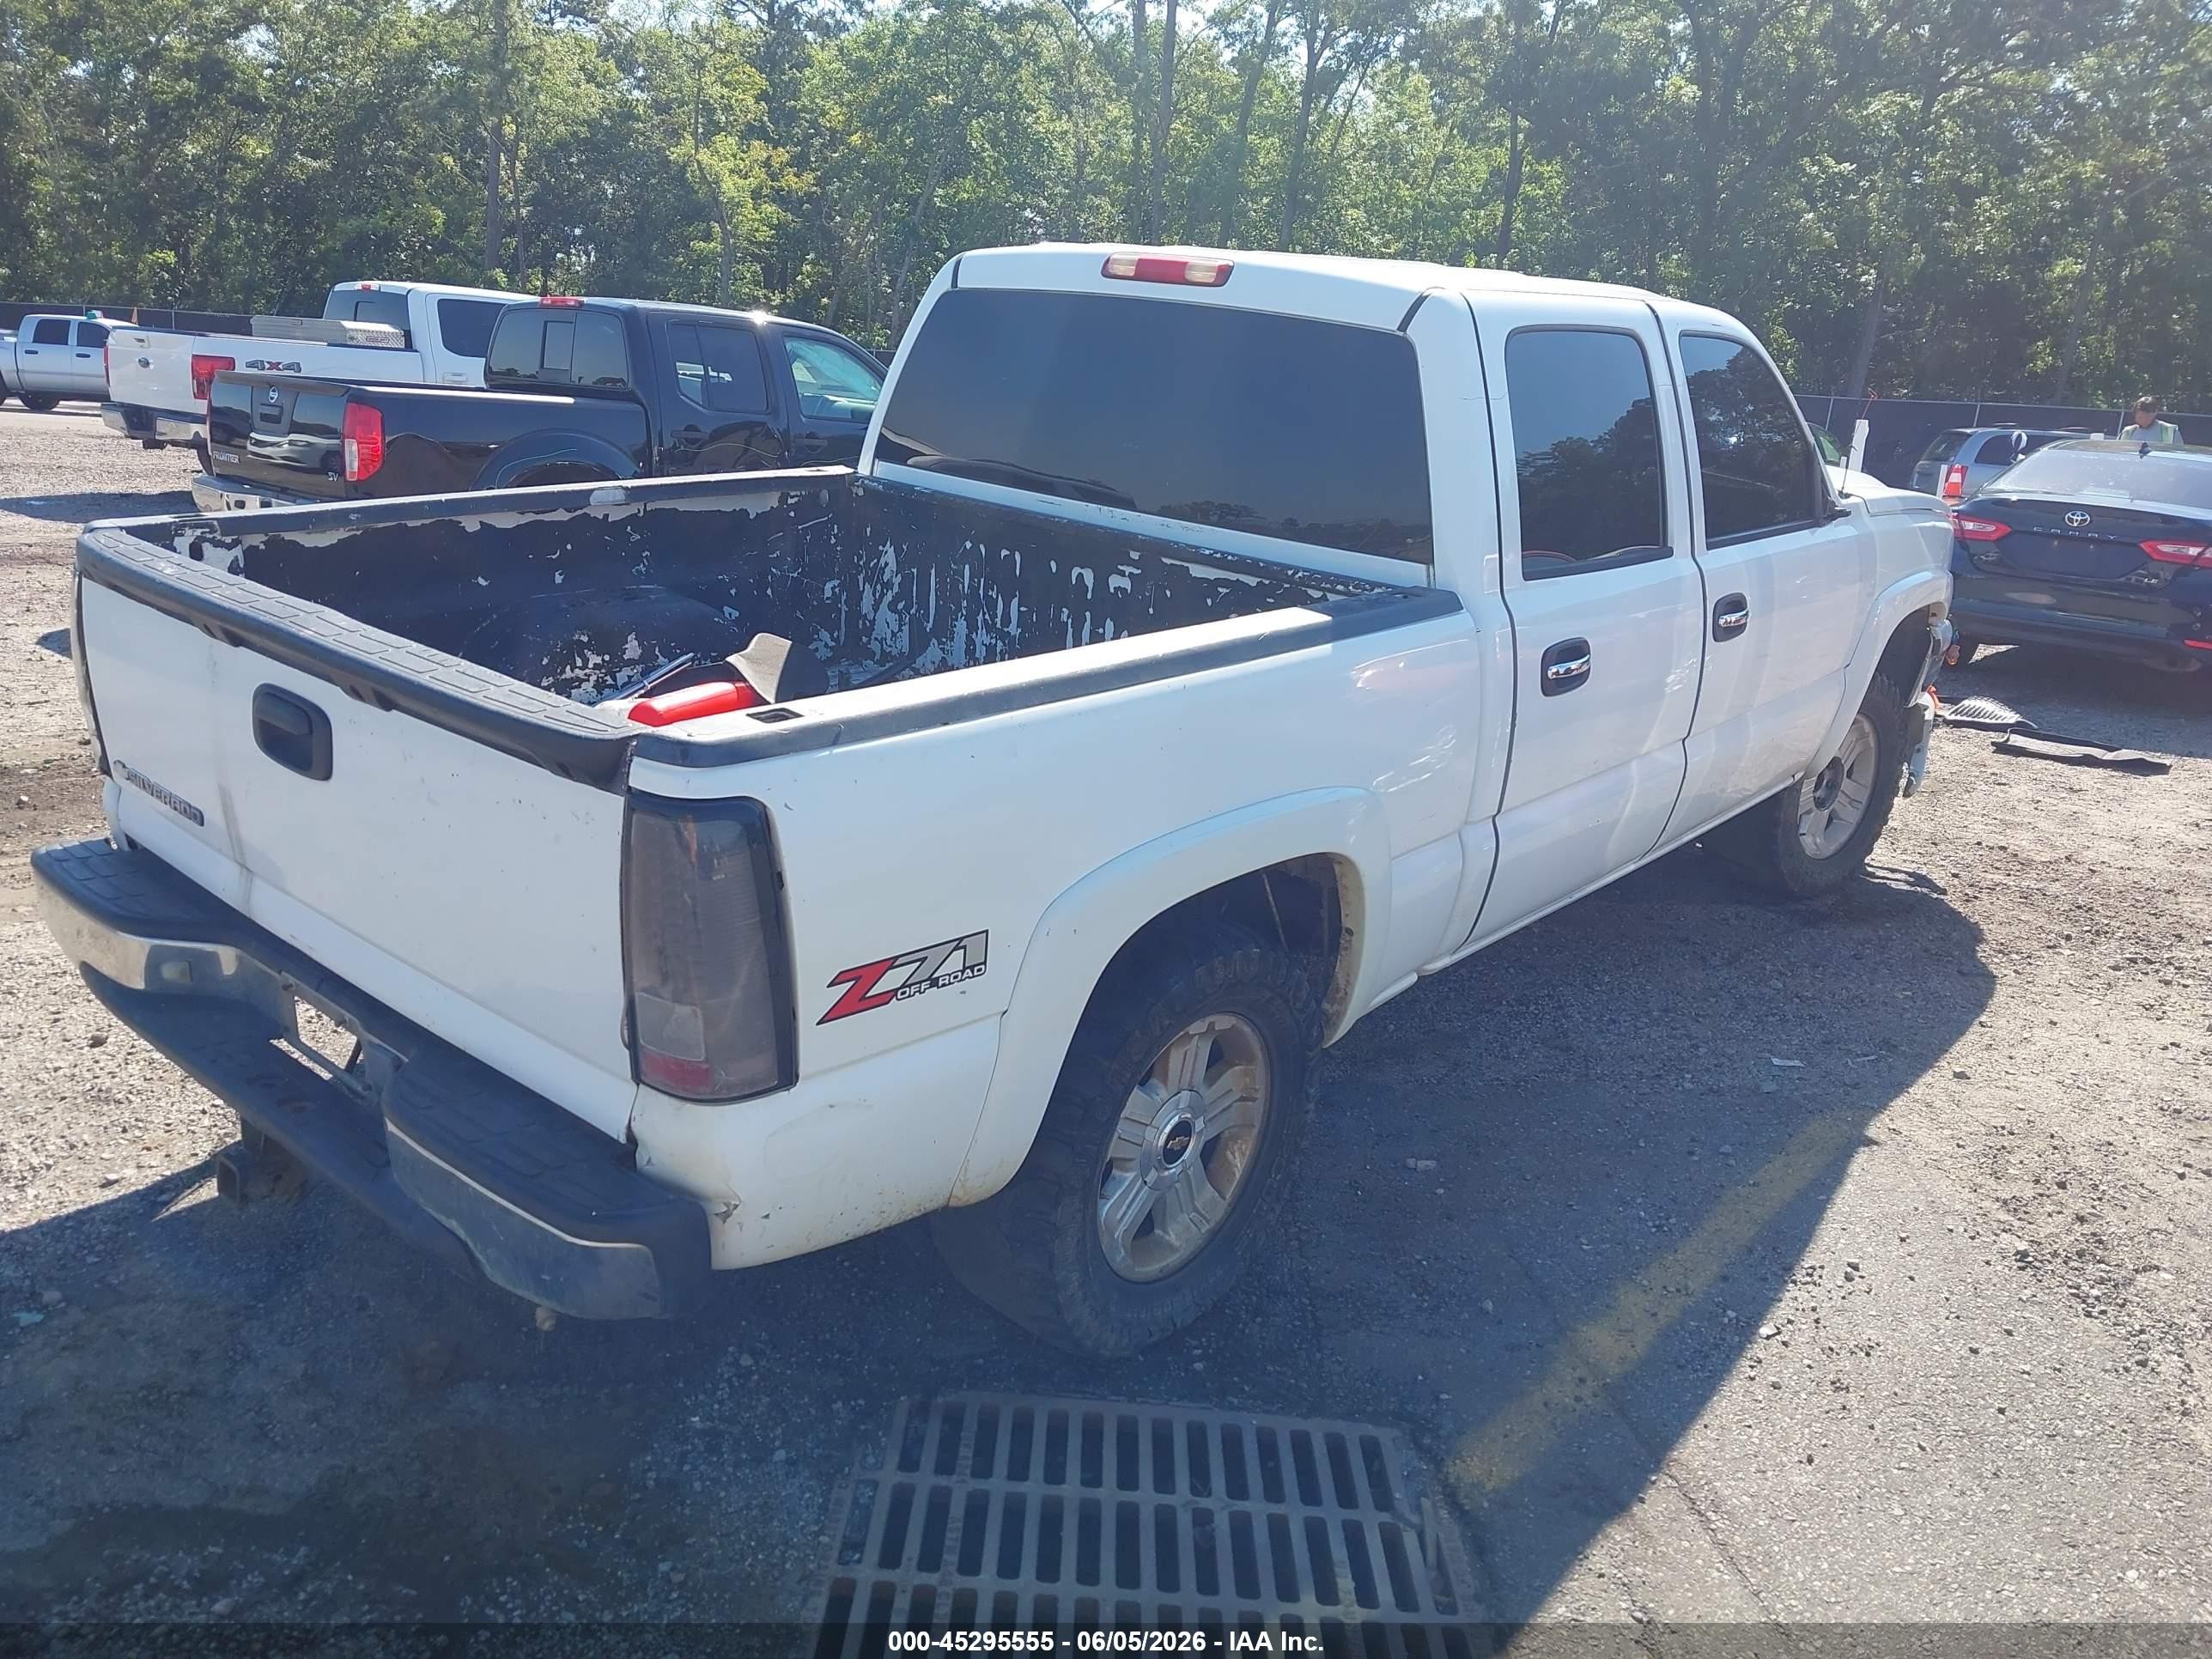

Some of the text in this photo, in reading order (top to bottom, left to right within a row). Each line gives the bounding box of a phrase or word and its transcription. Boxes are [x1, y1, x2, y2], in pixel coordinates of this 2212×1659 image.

[212, 450, 240, 465] FRONTIER
[328, 471, 339, 482] SV
[2033, 526, 2118, 539] CAMRY
[816, 928, 988, 1026] Z71
[896, 964, 987, 1001] OFF ROAD
